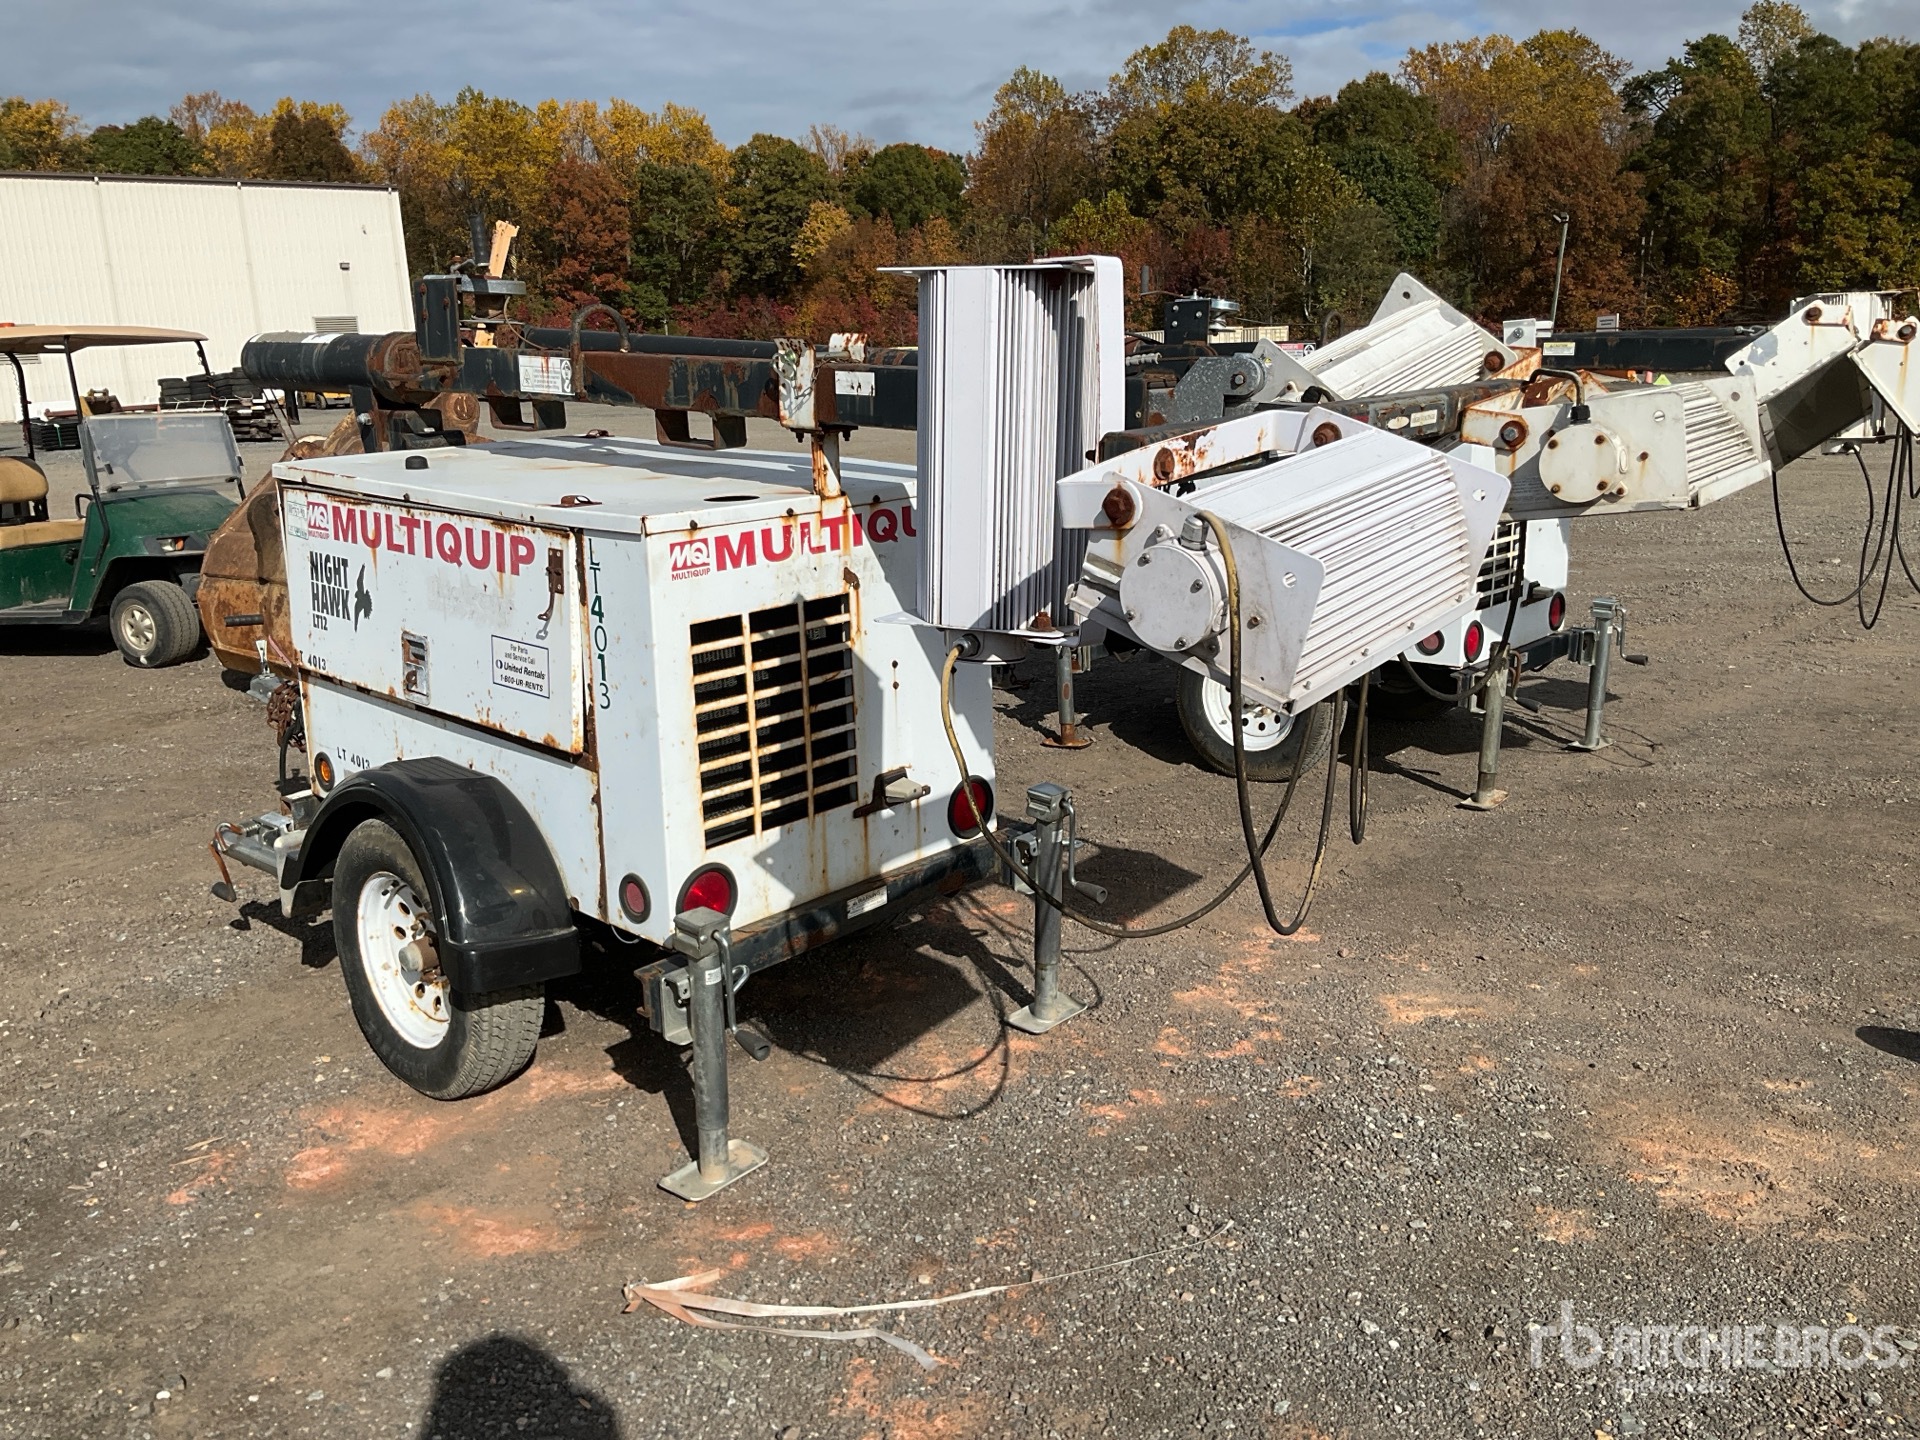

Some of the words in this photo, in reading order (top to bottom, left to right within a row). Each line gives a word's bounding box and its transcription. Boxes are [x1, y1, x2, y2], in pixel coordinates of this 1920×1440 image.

[332, 505, 535, 576] MULTIQUIP
[669, 538, 710, 572] MQ
[309, 550, 349, 590] NIGHT
[671, 567, 711, 581] MULTIQUIP
[311, 581, 351, 621] HAWK
[510, 643, 518, 652] For
[518, 645, 528, 655] Parts
[513, 653, 527, 664] Service
[307, 655, 327, 671] 4013
[504, 661, 523, 674] United
[524, 666, 546, 680] Rentals
[500, 674, 543, 692] 1-800-UR-RENTS
[336, 746, 346, 761] LT
[350, 753, 371, 770] 4013
